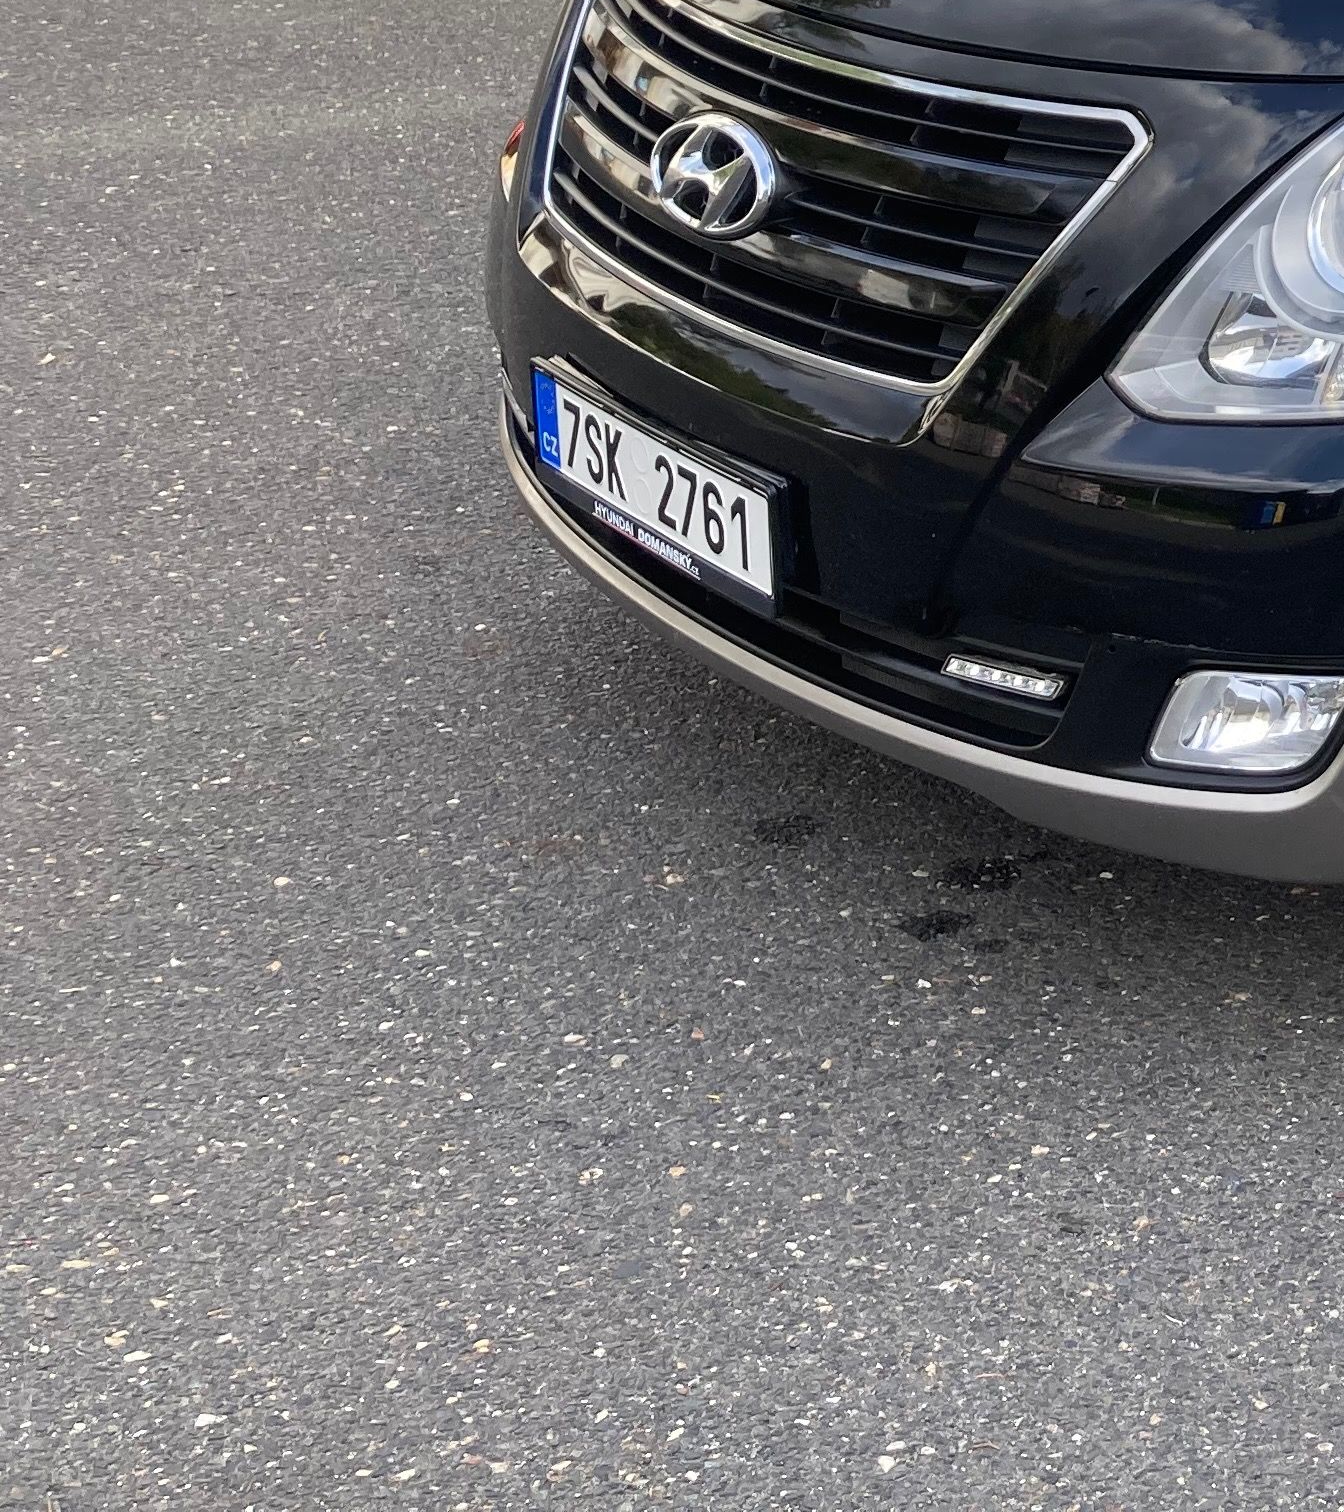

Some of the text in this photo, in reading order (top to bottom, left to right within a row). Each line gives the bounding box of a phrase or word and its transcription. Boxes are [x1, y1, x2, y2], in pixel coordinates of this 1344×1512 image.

[543, 432, 559, 458] CZ
[563, 398, 749, 571] 7SK 2761
[594, 501, 634, 536] HYUNDAI
